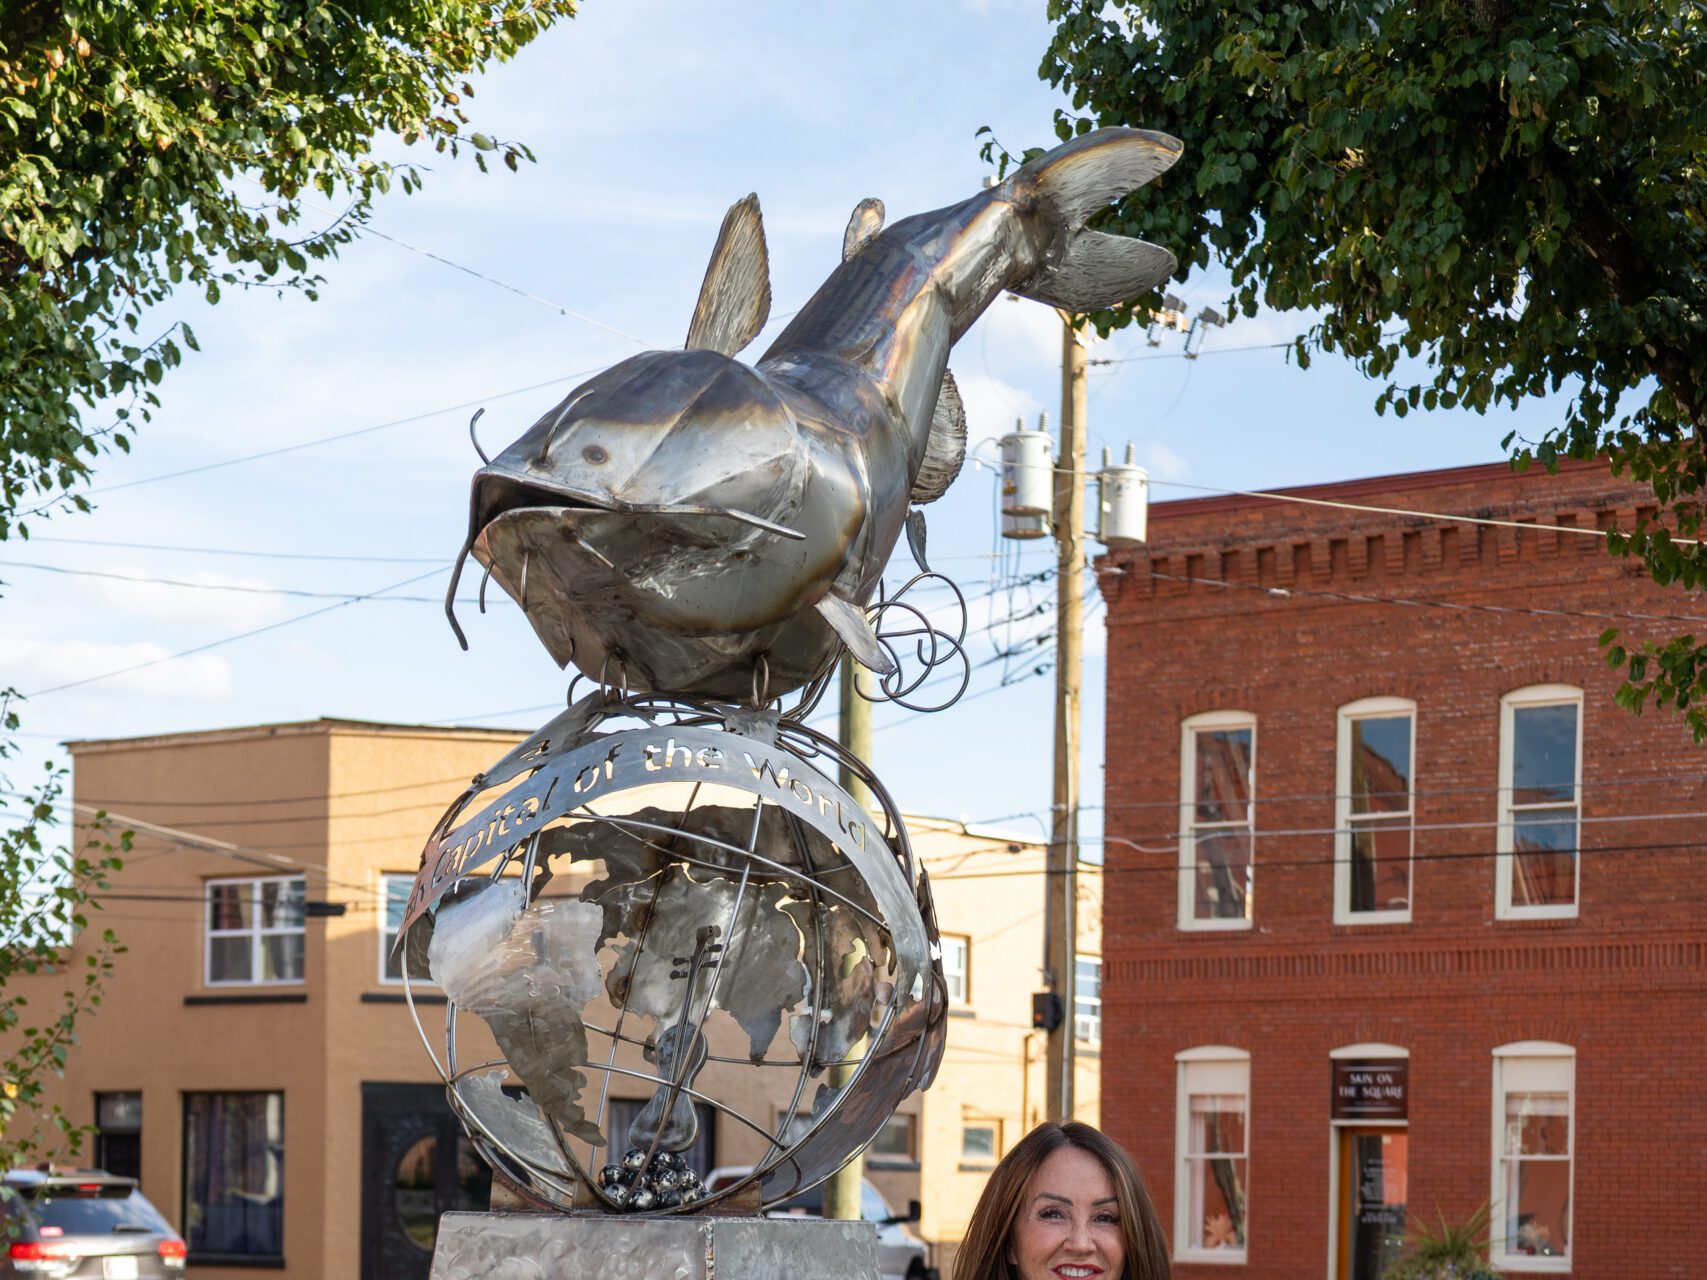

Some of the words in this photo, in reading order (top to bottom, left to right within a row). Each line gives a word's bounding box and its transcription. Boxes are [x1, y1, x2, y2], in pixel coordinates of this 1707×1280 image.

[431, 776, 560, 889] Capital
[573, 742, 624, 793] of
[643, 738, 724, 772] the
[743, 751, 866, 853] World
[1349, 1072, 1374, 1085] SKIN
[1376, 1072, 1394, 1085] ON
[1339, 1086, 1357, 1098] THE
[1361, 1086, 1403, 1100] SQUARE
